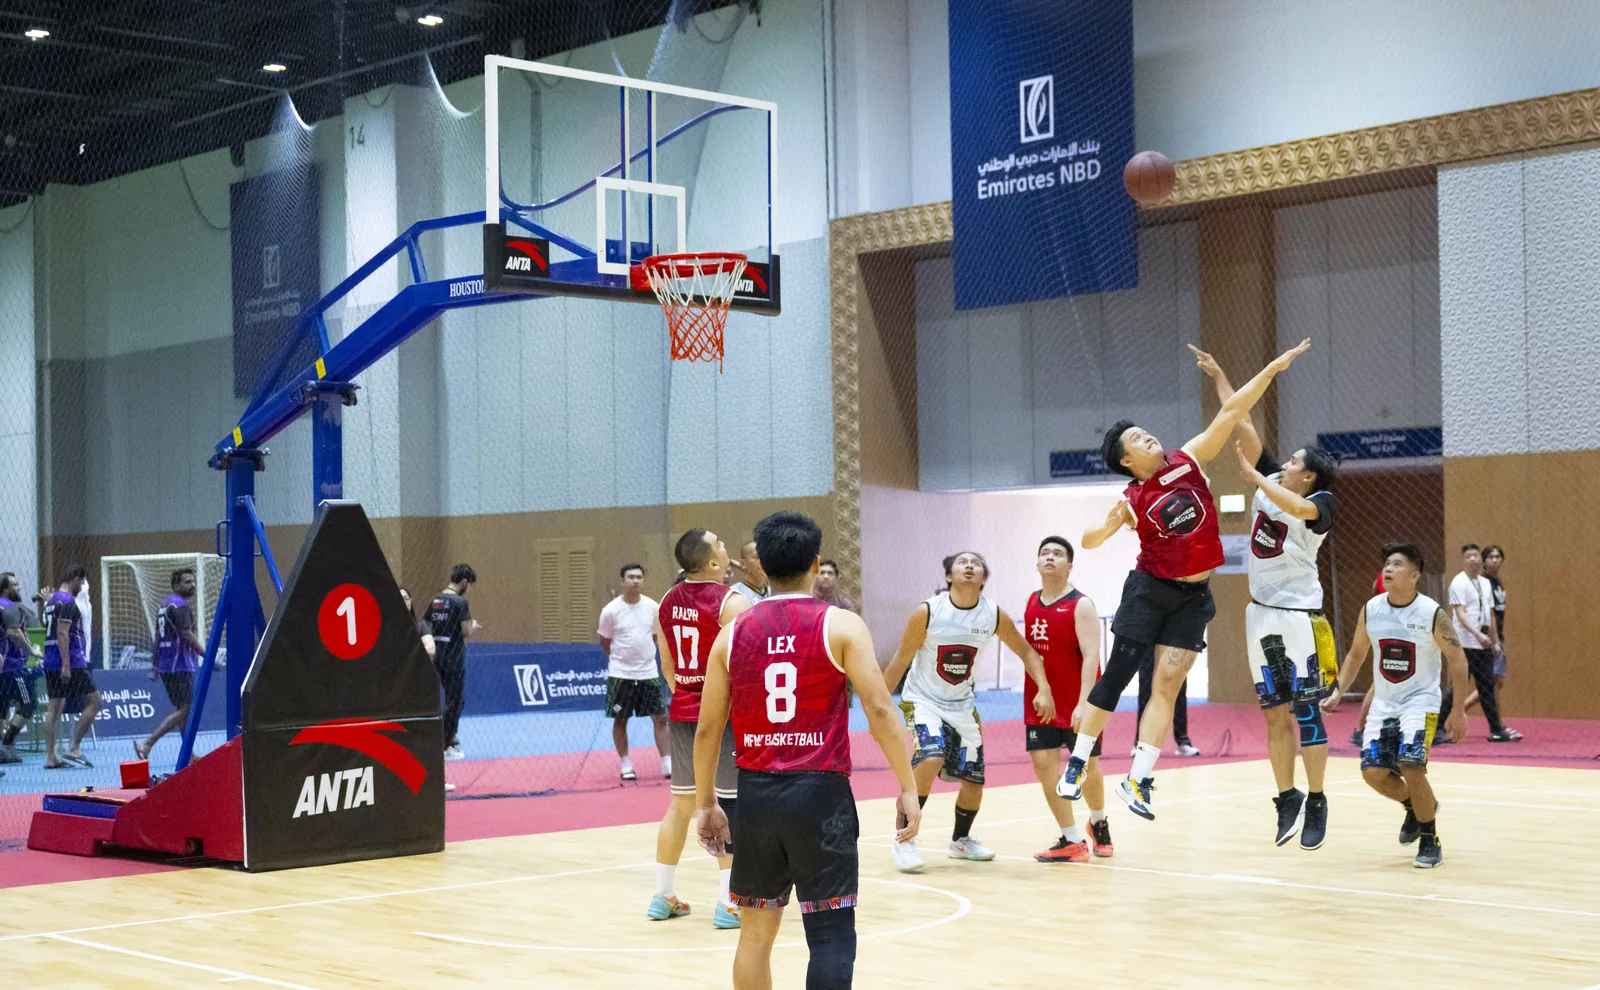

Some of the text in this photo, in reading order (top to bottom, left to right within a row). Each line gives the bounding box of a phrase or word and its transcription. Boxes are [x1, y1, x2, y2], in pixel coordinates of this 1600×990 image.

[349, 124, 365, 148] 14
[1078, 140, 1101, 155] بنك
[977, 153, 1015, 177] الوطني
[1015, 153, 1039, 169] دبي
[977, 159, 1101, 200] Emirates NBD
[505, 255, 531, 271] ANTA
[336, 596, 357, 645] 1
[672, 605, 699, 621] RALPH
[1030, 617, 1050, 642] 柱
[672, 624, 700, 670] 17
[767, 635, 796, 655] LEX
[547, 683, 608, 698] Emirates
[764, 661, 798, 724] 8
[115, 703, 155, 719] NBD
[764, 732, 825, 746] BASKETBALL
[292, 765, 375, 819] ANTA
